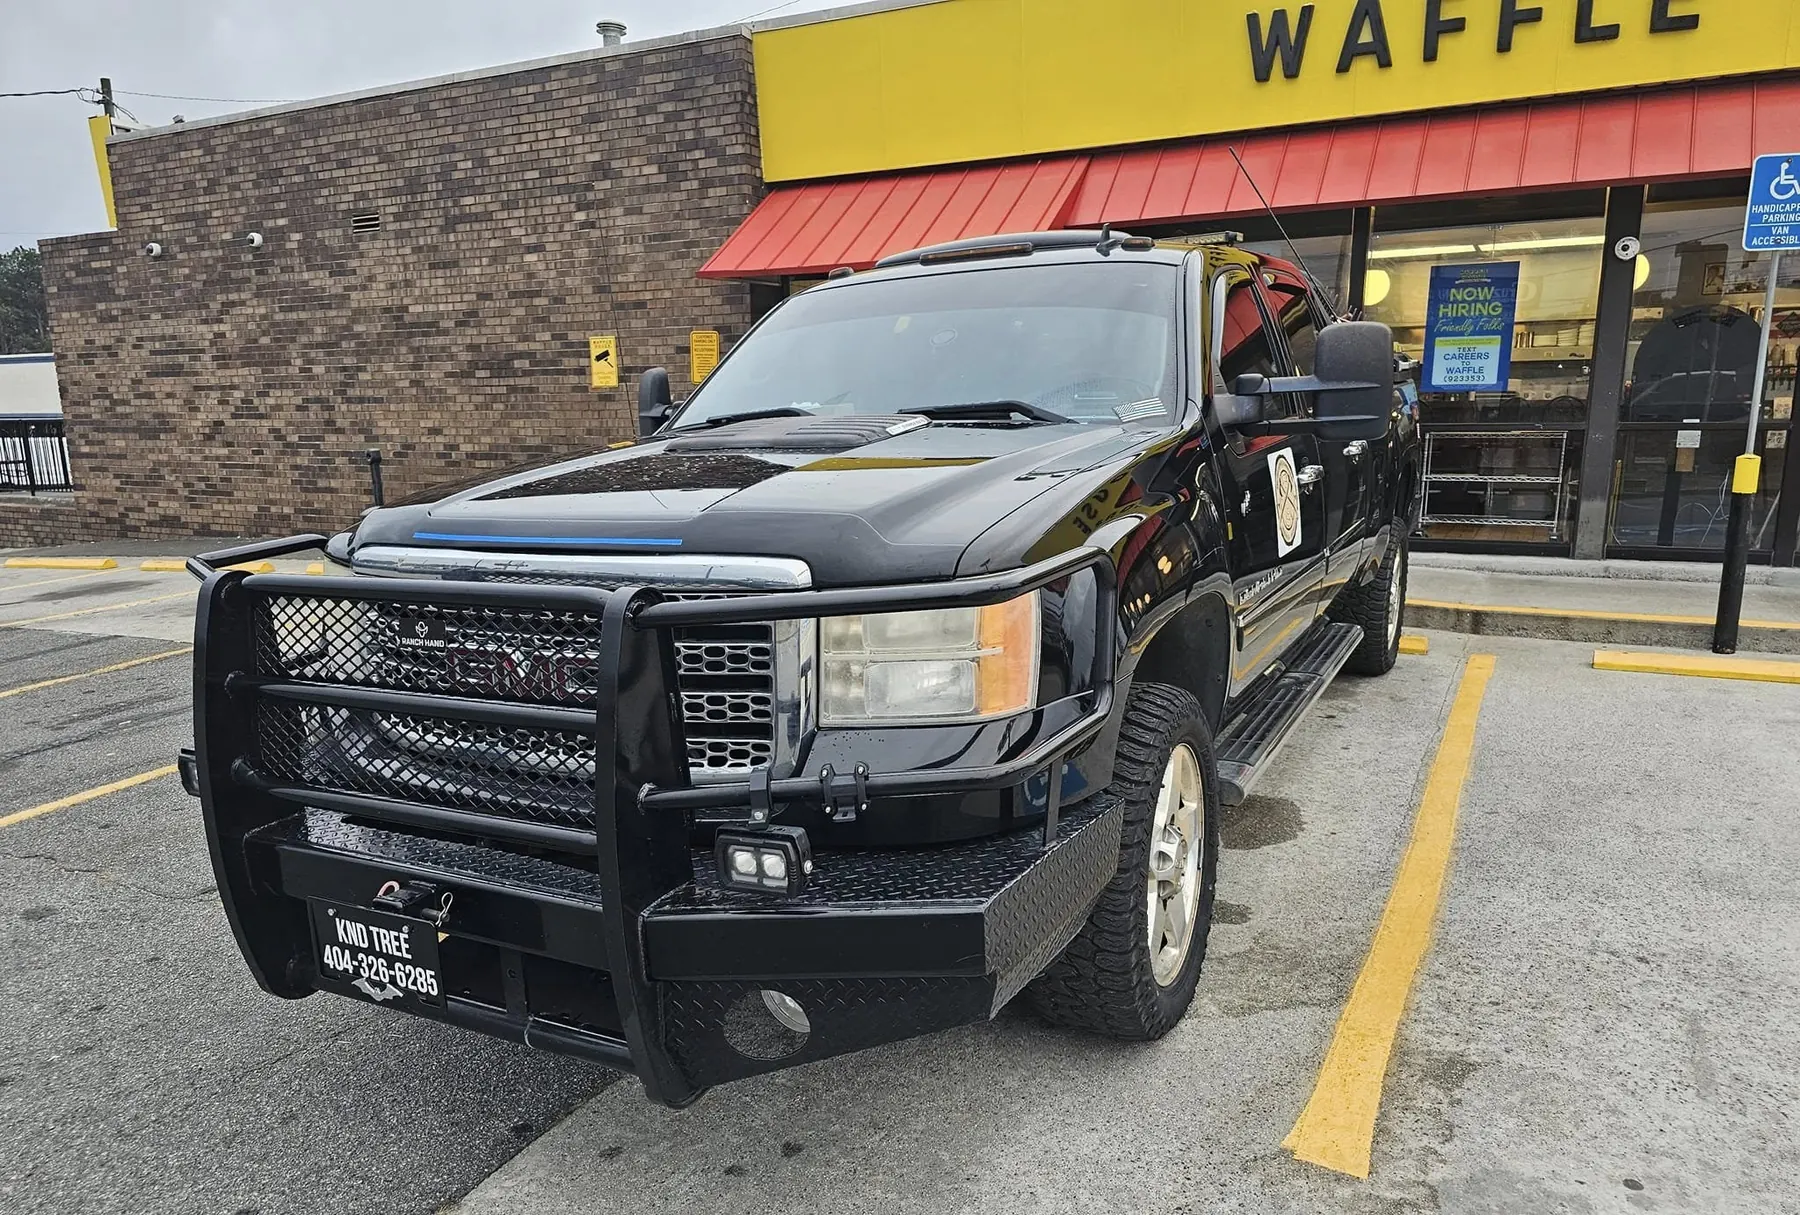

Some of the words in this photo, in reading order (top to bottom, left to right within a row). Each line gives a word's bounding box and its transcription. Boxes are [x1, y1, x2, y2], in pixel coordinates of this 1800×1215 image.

[1762, 213, 1800, 223] PARKING
[1771, 226, 1789, 235] VAN
[1449, 286, 1495, 301] NOW
[1439, 301, 1503, 318] HIRING
[1434, 319, 1474, 335] Friendly
[1443, 352, 1490, 361] CAREERS
[1445, 366, 1485, 375] WAFFLE
[1443, 374, 1486, 383] (923353)
[401, 637, 424, 647] RANCH
[424, 638, 445, 648] HAND
[335, 917, 369, 949] KND
[368, 925, 413, 960] TREE
[323, 944, 439, 996] 404-326-6285
